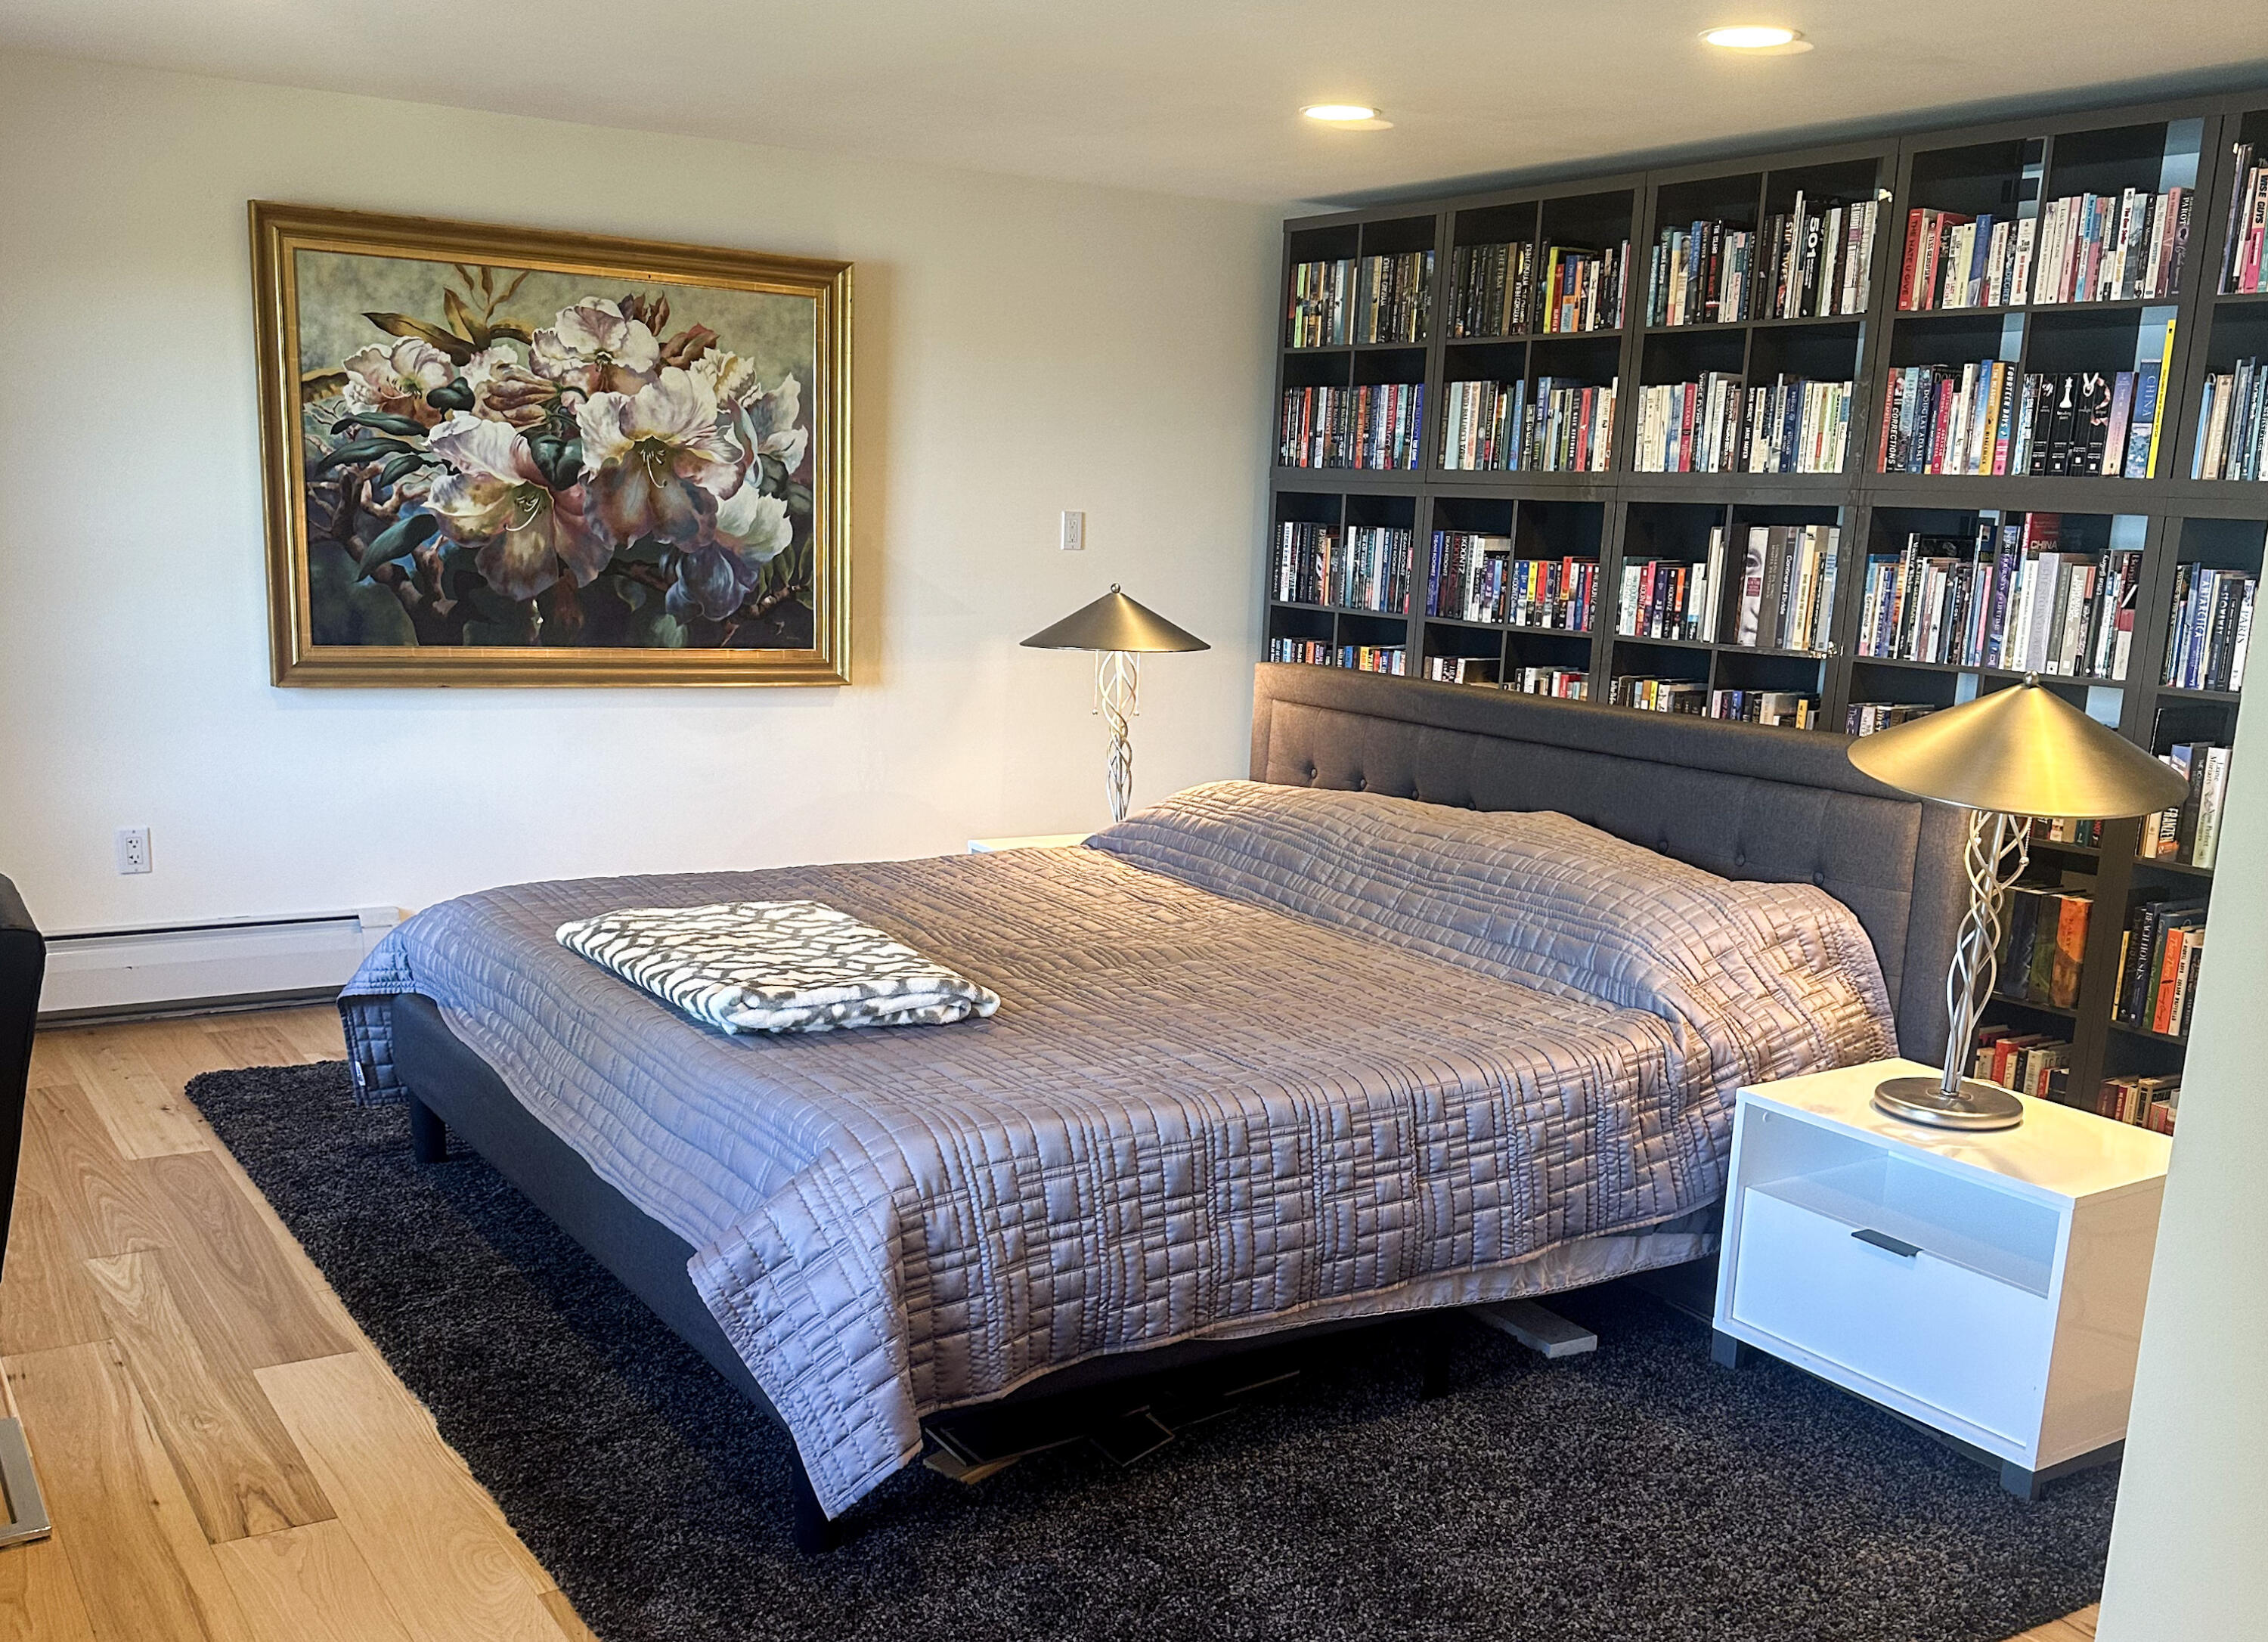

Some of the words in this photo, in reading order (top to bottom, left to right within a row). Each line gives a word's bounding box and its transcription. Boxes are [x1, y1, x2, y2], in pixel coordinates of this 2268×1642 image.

[2259, 175, 2267, 197] WISE
[2180, 197, 2191, 225] PAROT
[2254, 201, 2265, 224] GUYS
[1783, 222, 1793, 249] STILL
[1806, 217, 1820, 258] 501
[1910, 221, 1918, 237] THE
[1498, 248, 1506, 267] THE
[1906, 240, 1915, 264] HATE
[1496, 268, 1504, 289] FIRM
[1780, 252, 1791, 281] LIVES
[2002, 271, 2012, 305] DEGREE
[1696, 373, 1706, 398] VINCE
[2003, 366, 2015, 407] FOURTEEN
[2142, 375, 2157, 418] CHINA
[1919, 389, 1930, 430] DOUGLAS
[2000, 407, 2010, 429] DAYS
[1888, 407, 1899, 466] CORRECTIONS
[1916, 432, 1925, 462] ADAMS
[1458, 539, 1468, 575] KOONTZ
[2030, 540, 2058, 550] CHINA
[1430, 552, 1439, 577] KOONTZ
[1782, 554, 1793, 593] Continental
[1665, 584, 1675, 612] KOONTZ
[1779, 593, 1787, 616] Divide
[1863, 596, 1873, 628] Germania
[2194, 580, 2211, 639] ANTARCTICA
[2236, 609, 2250, 644] PARIS
[2205, 754, 2218, 786] Moriarty
[2214, 761, 2225, 782] Liane
[2159, 807, 2179, 844] FRANZEN
[2142, 911, 2154, 941] BEACH
[2167, 937, 2180, 957] There
[2135, 942, 2150, 981] HOUSES
[2164, 958, 2177, 979] There
